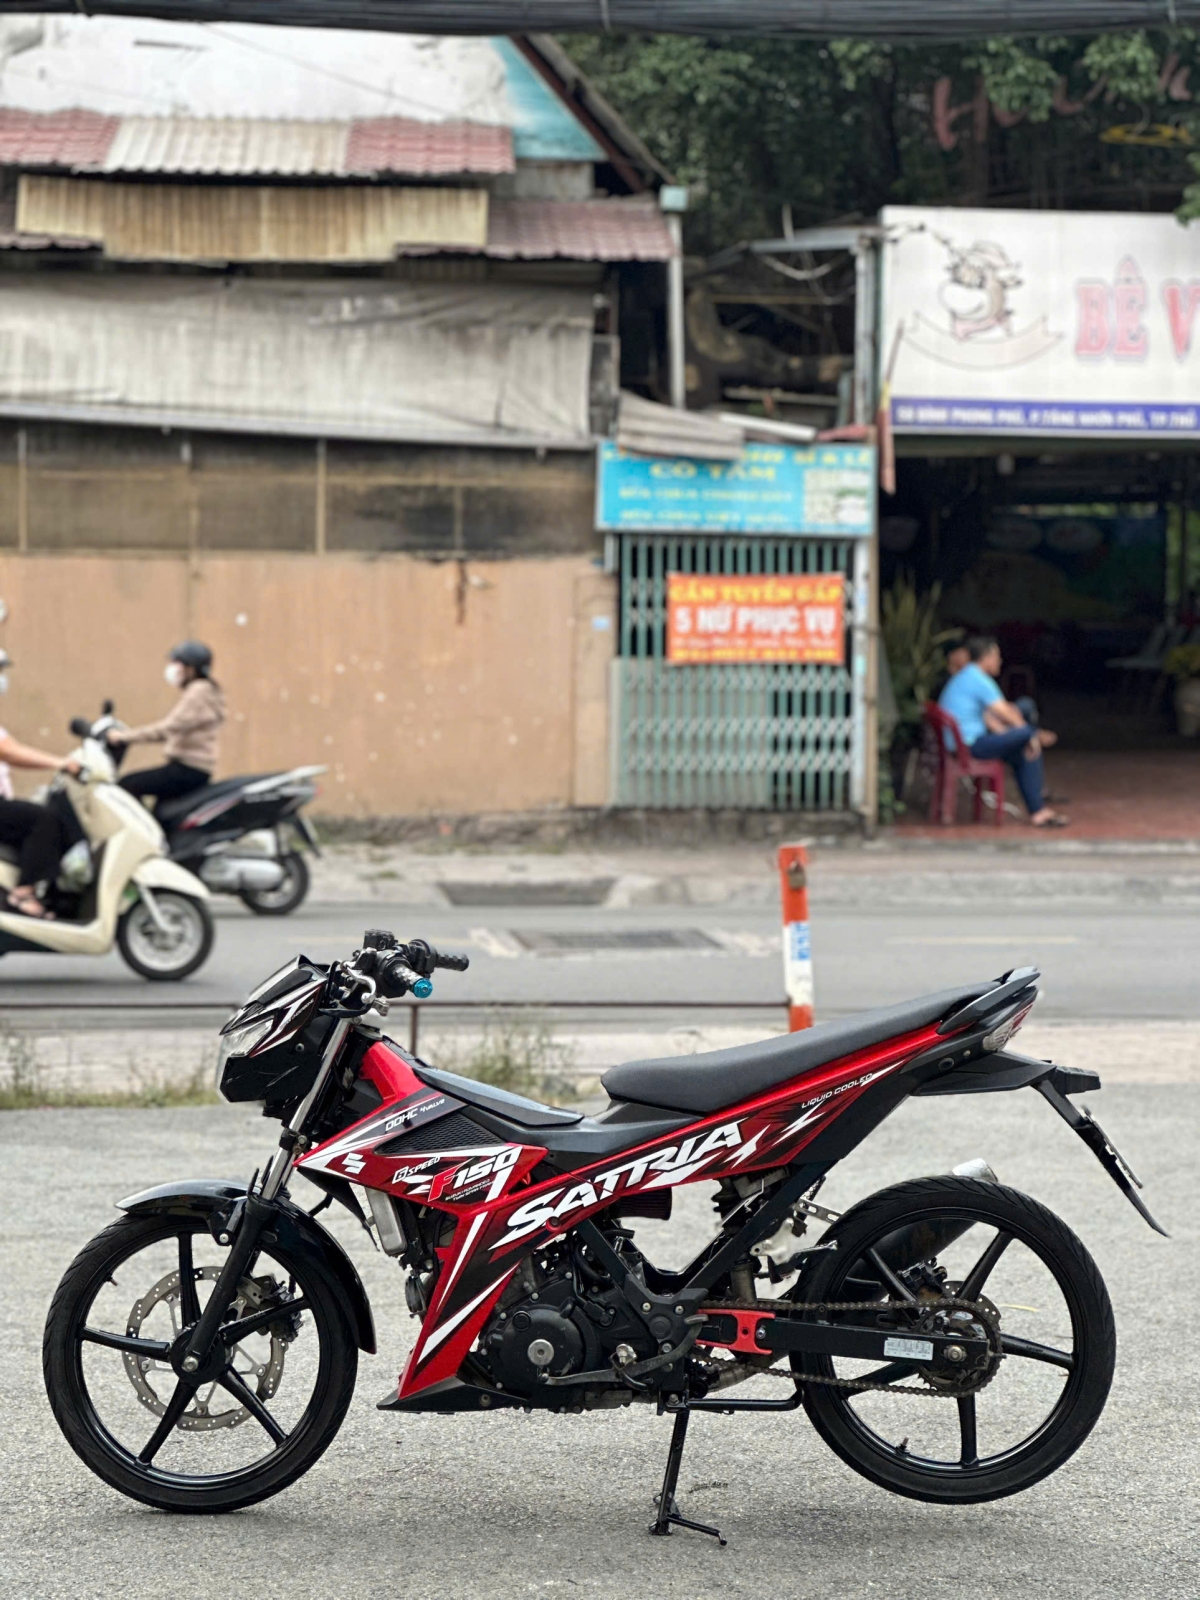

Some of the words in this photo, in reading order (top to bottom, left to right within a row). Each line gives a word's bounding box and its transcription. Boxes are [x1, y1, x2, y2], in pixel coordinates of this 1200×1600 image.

[1074, 254, 1148, 362] BÊ
[801, 1091, 833, 1109] LIQUID
[834, 1073, 873, 1095] COOLED
[385, 1107, 418, 1132] DOHC
[428, 1146, 523, 1202] F150
[488, 1117, 750, 1251] SATRIA
